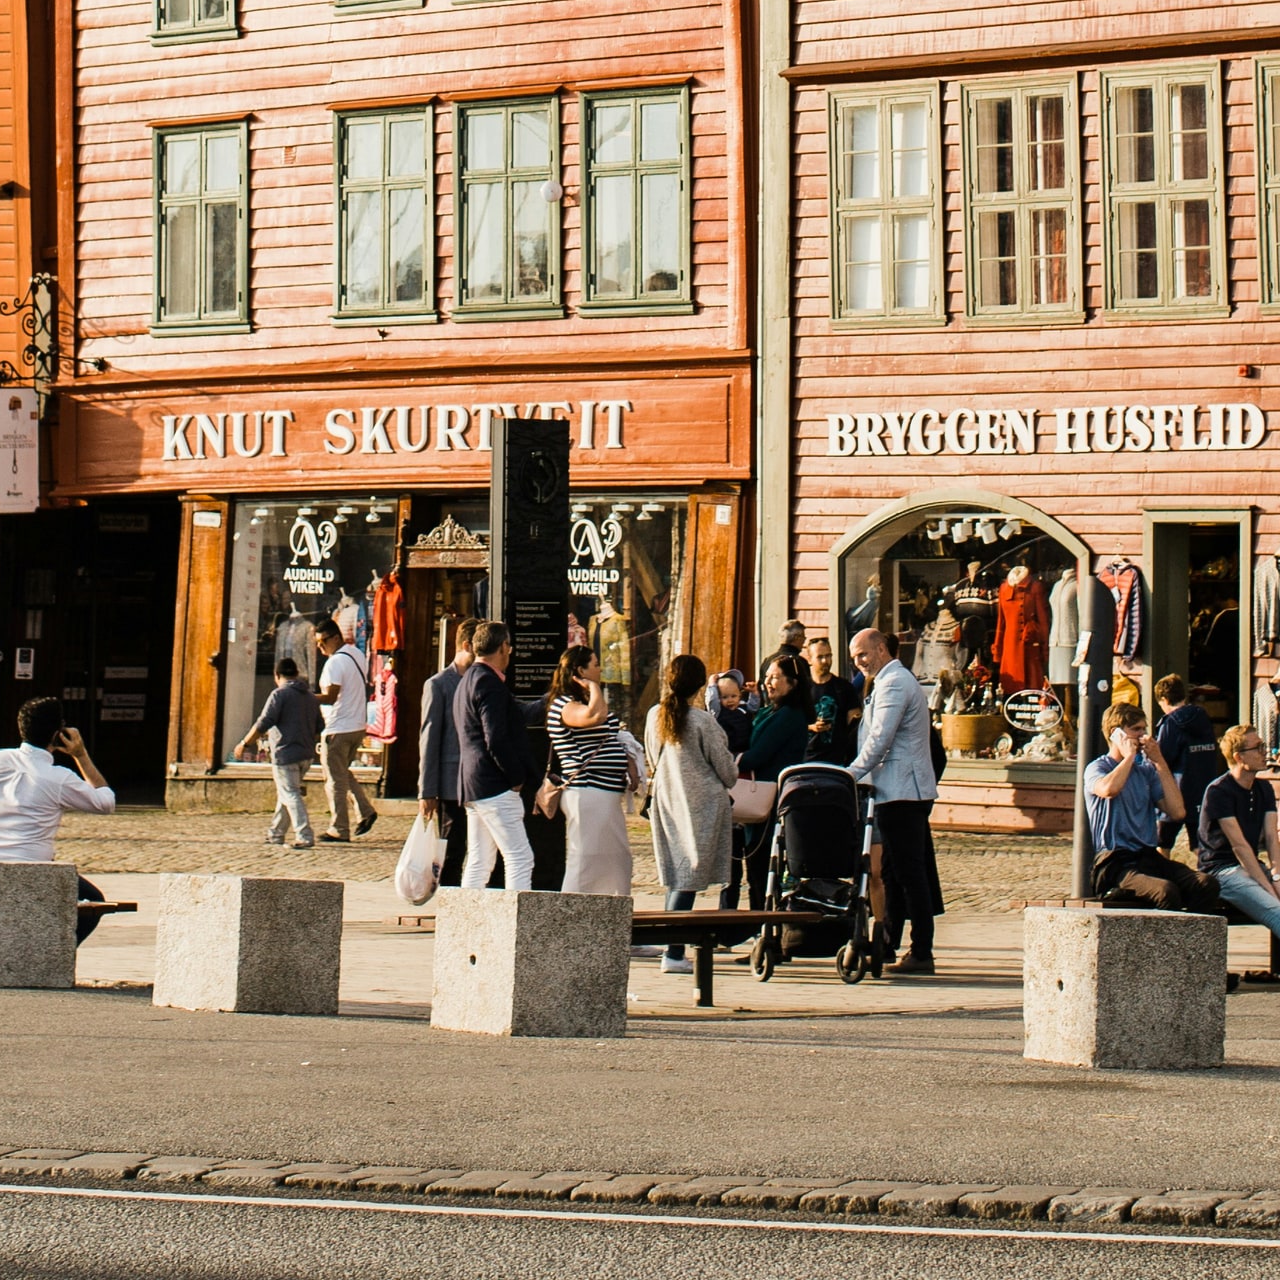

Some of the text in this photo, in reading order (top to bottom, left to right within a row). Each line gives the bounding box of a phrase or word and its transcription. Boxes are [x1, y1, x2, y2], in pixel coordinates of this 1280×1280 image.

[162, 400, 632, 461] KNUT SKURTIT
[825, 402, 1268, 457] BRYGGEN HUSFLID
[283, 567, 335, 582] AUDHILD
[289, 580, 324, 594] VIKEN
[570, 582, 608, 595] VIKEN
